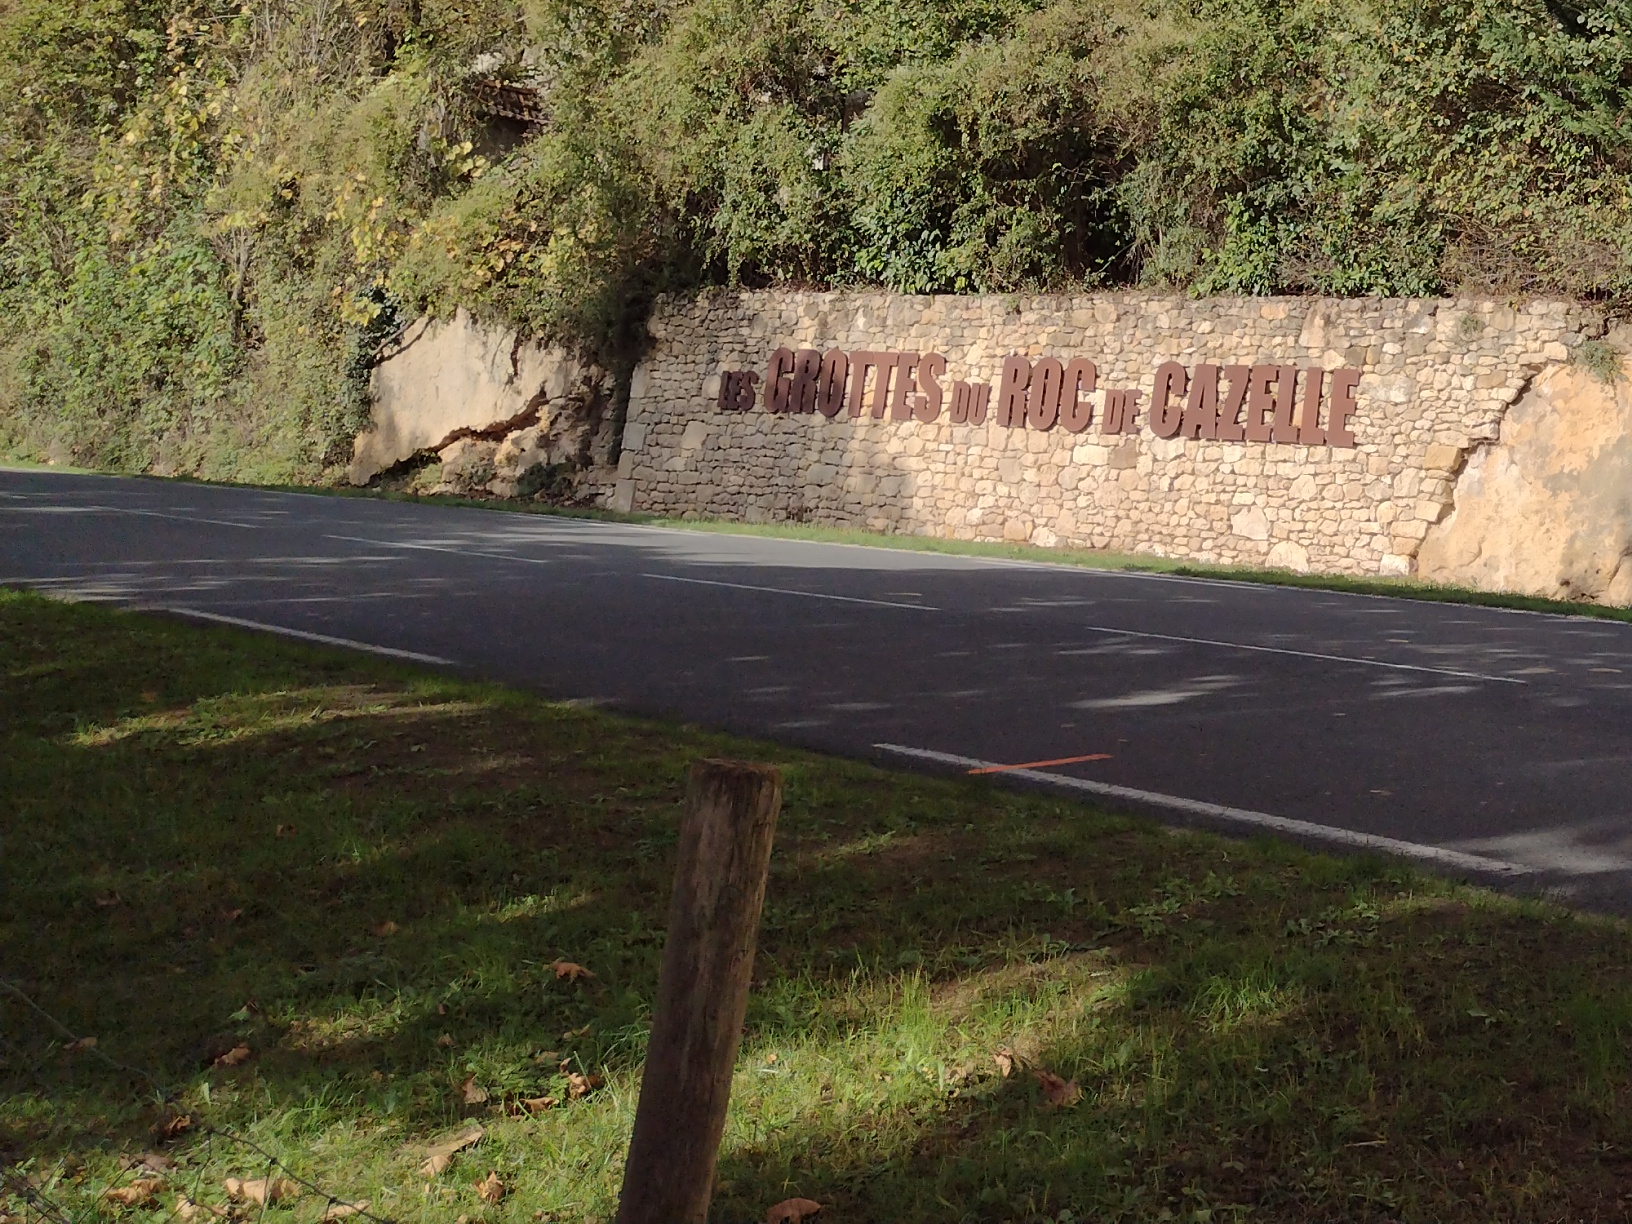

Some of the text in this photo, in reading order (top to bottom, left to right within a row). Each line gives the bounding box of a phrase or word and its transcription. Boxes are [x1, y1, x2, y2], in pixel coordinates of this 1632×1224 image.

[717, 347, 1361, 447] LES GROTTES DU ROC DE CAZELLE
